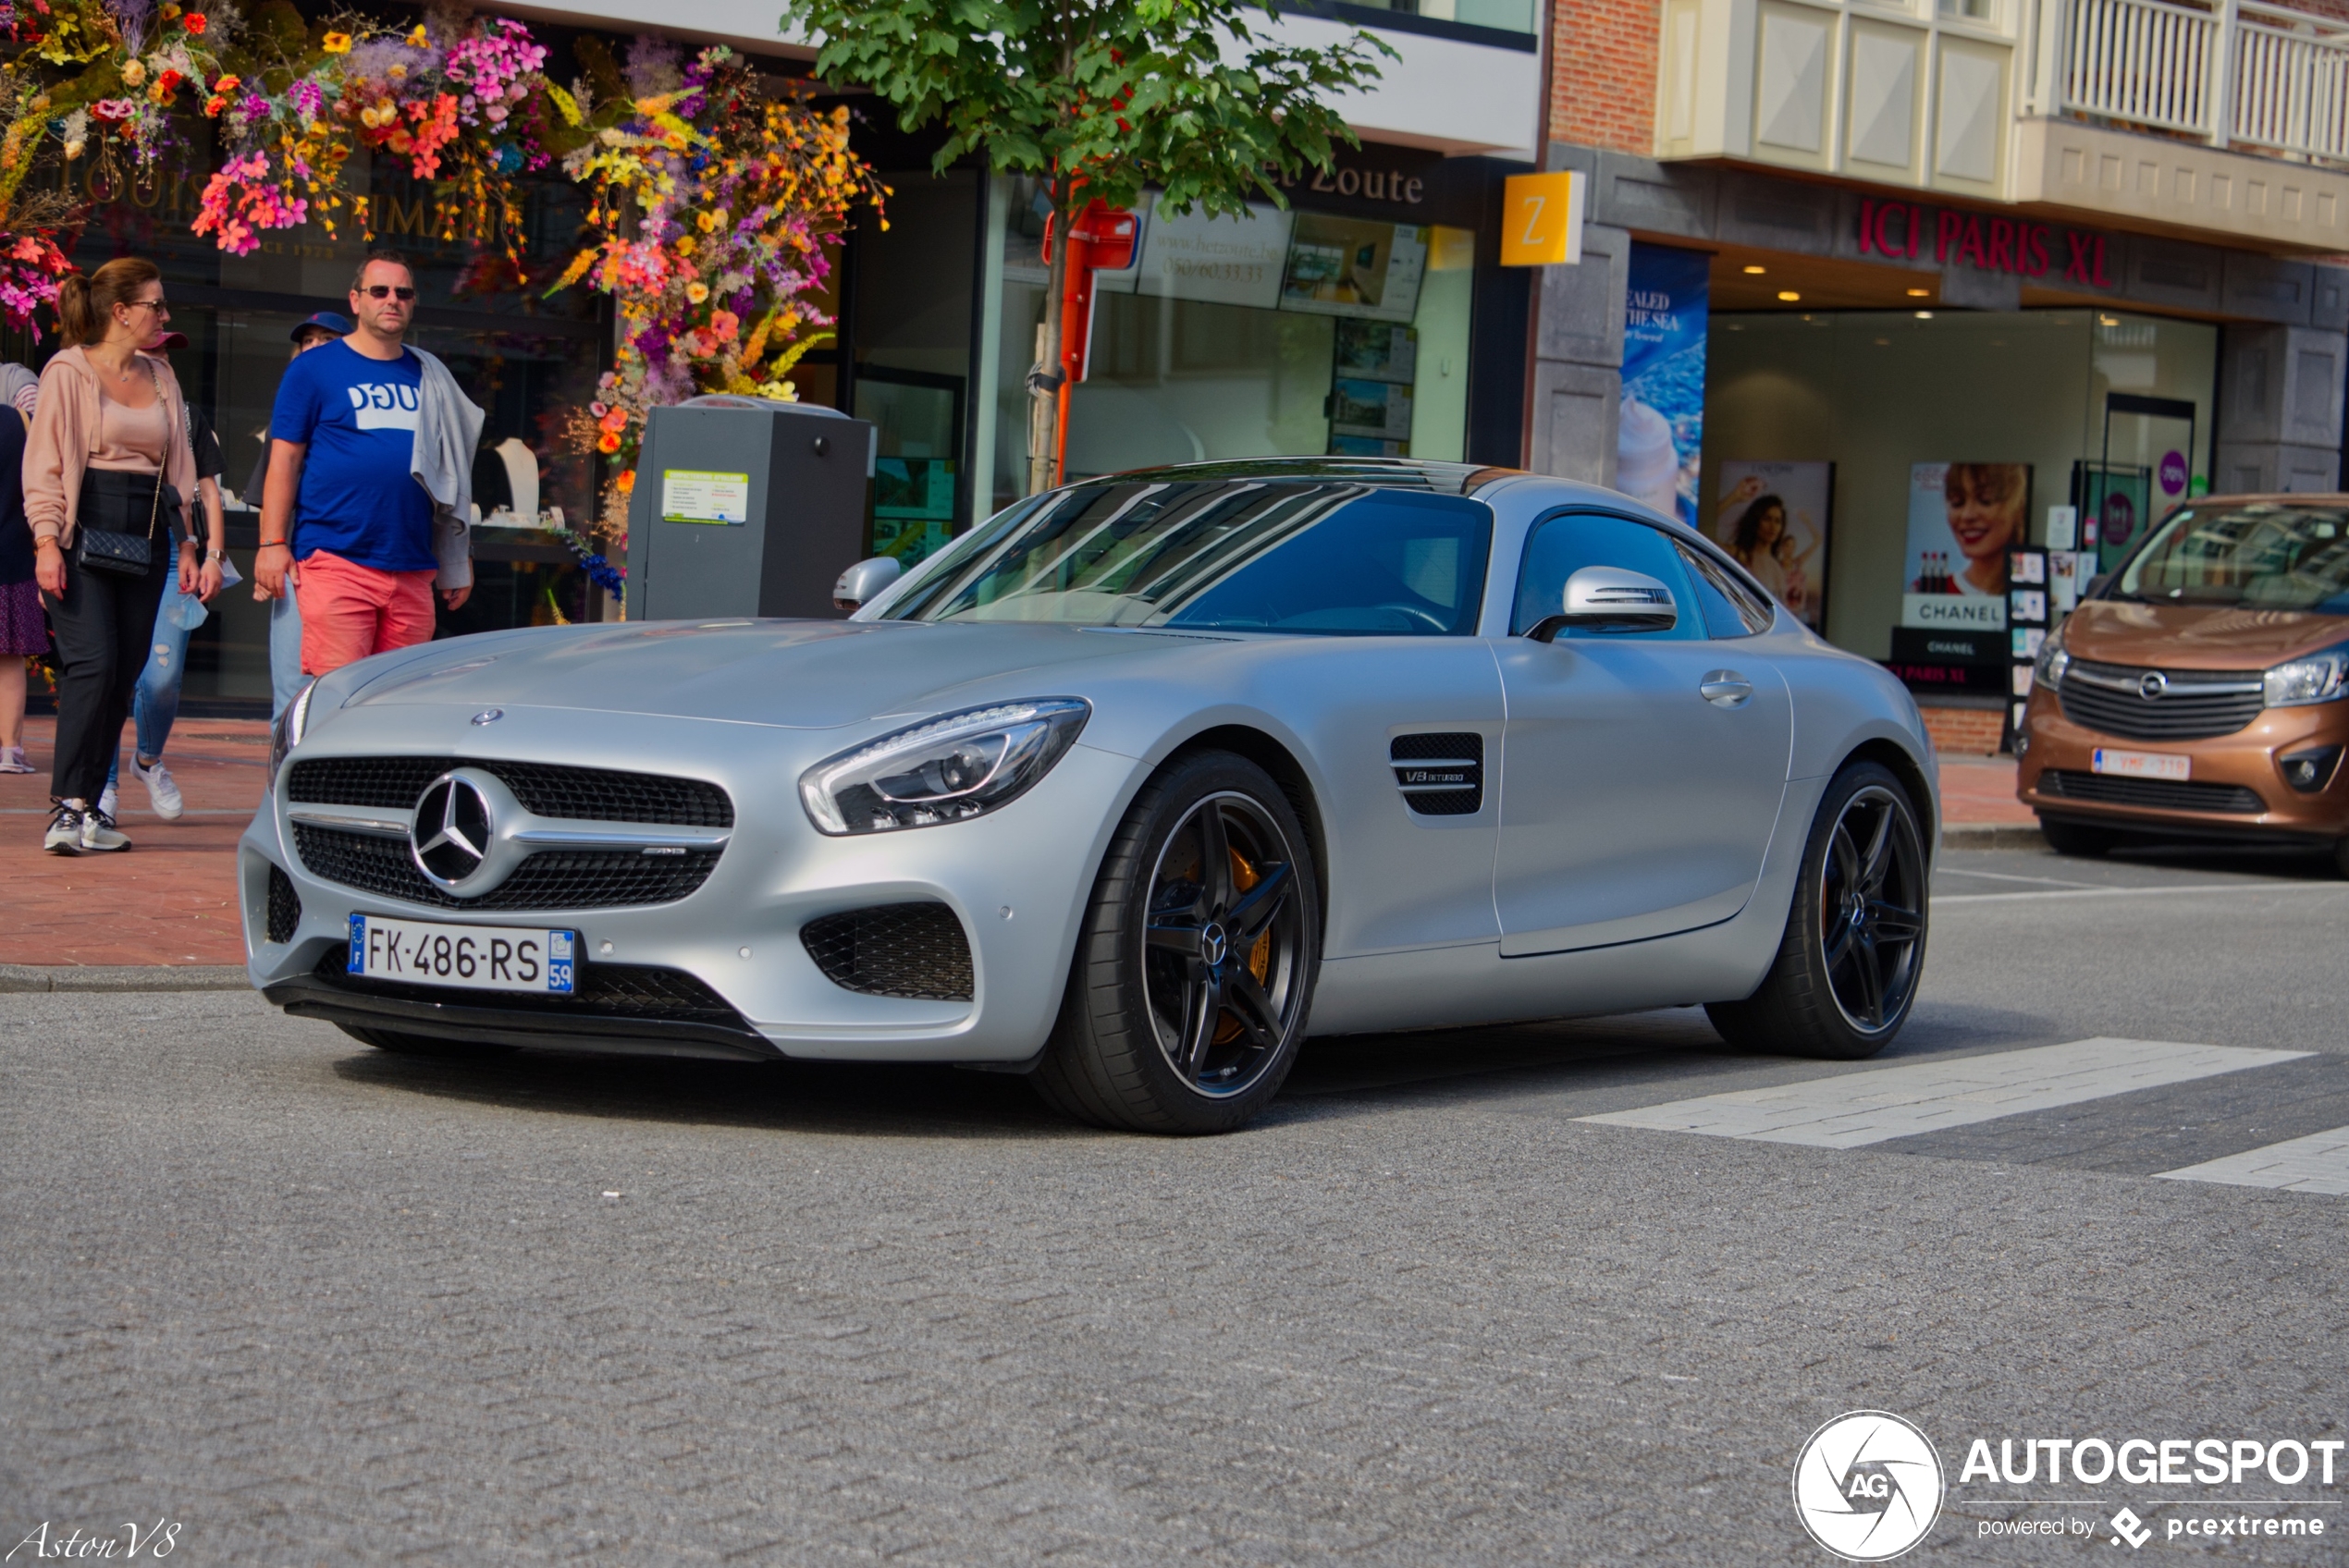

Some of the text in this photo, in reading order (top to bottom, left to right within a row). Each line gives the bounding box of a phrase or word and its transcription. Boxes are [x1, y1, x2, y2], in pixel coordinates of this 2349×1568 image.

[1310, 152, 1424, 204] Zoute
[1521, 195, 1547, 245] Z
[1859, 199, 2113, 288] ICI PARIS XL
[1625, 289, 1670, 312] EALED
[1652, 312, 1681, 333] SEA
[1919, 604, 2000, 623] CHANEL
[1927, 640, 1975, 655] CHANEL
[1905, 665, 1947, 682] PARIS
[1406, 771, 1464, 782] V8 BITURBO
[353, 951, 362, 966] F
[370, 927, 540, 983] FK-486-RS
[548, 964, 572, 987] 59
